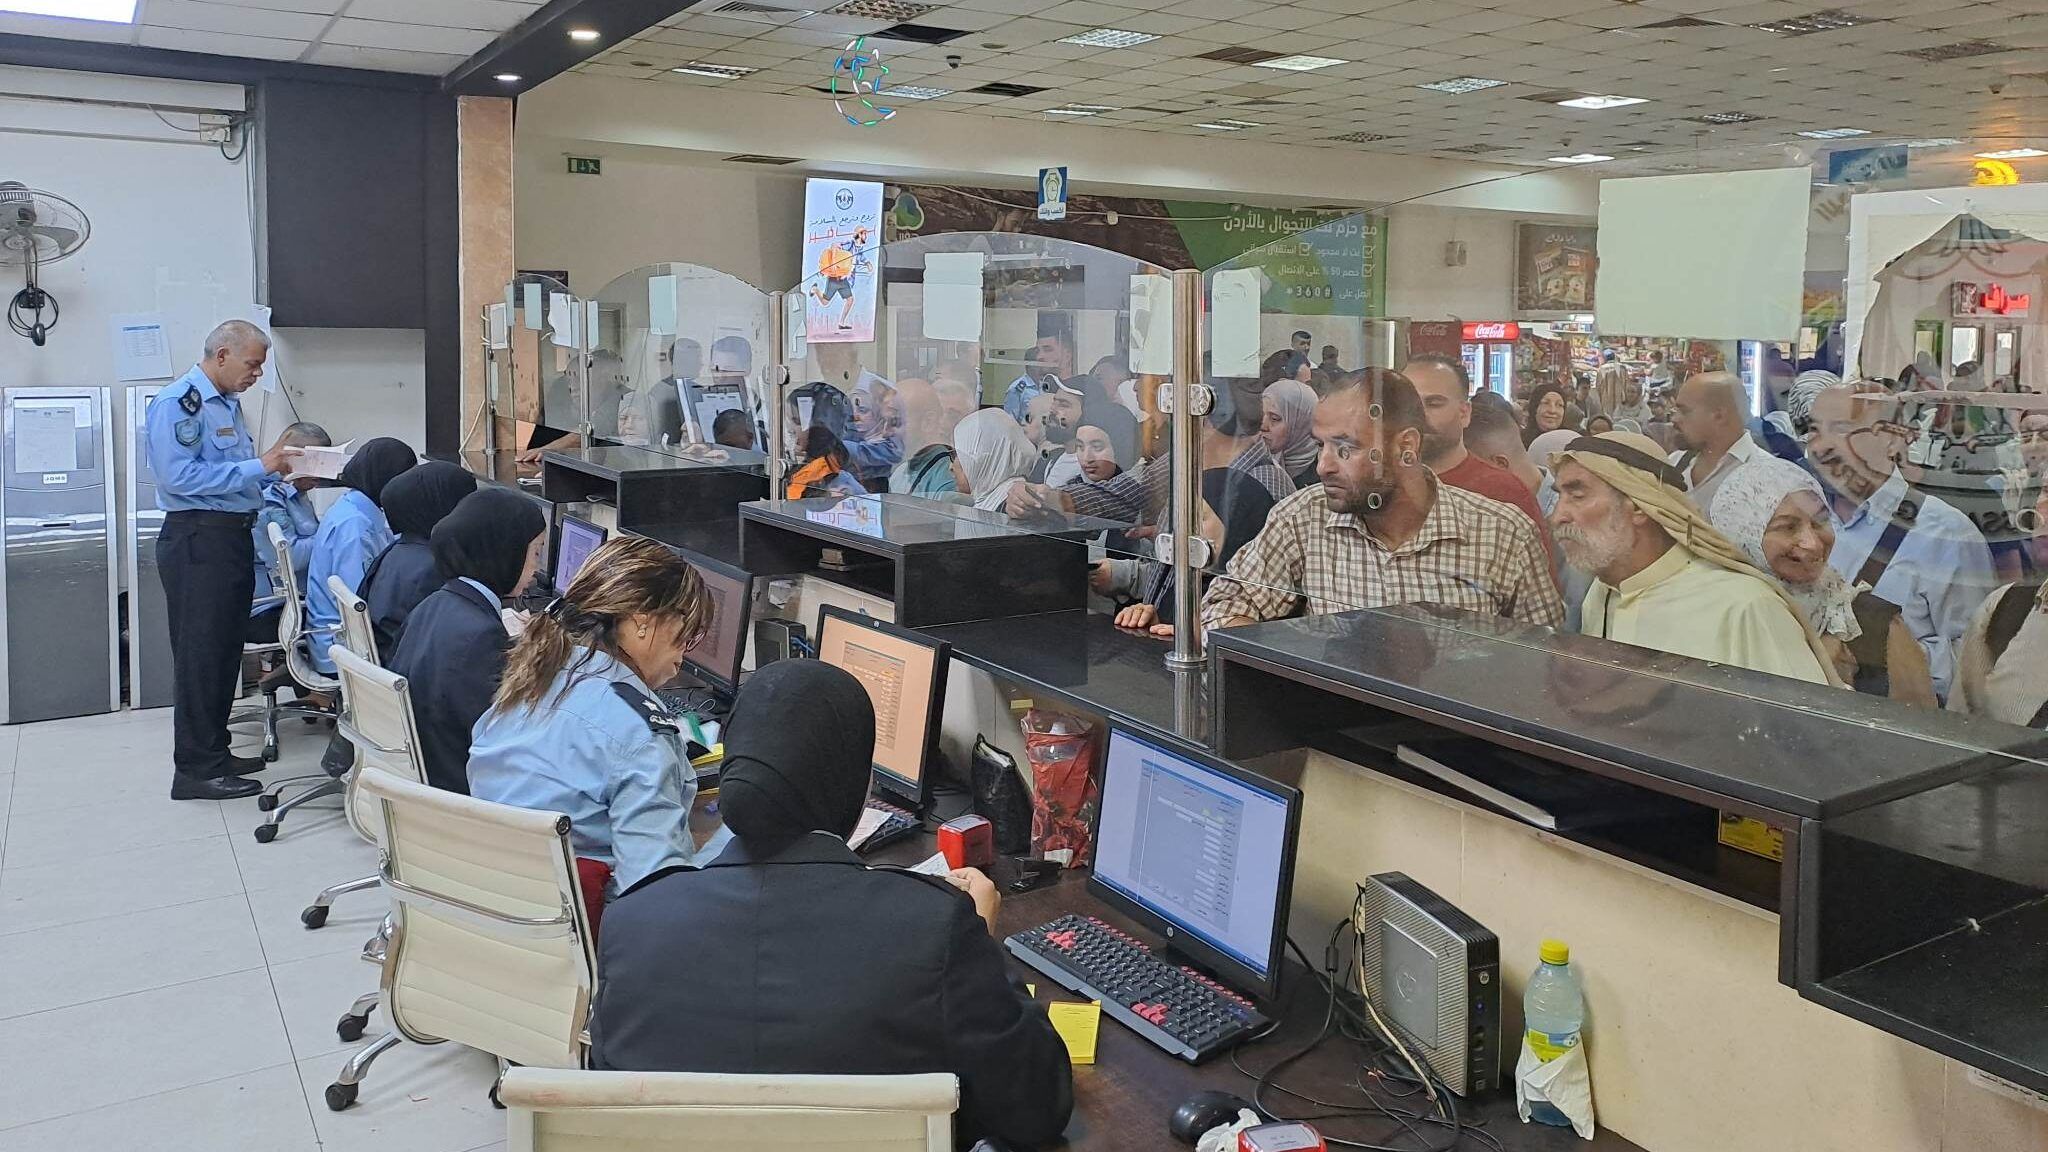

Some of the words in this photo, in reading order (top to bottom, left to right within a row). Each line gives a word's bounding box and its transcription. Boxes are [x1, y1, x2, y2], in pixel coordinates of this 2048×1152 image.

[1223, 211, 1265, 232] بالأردن
[1269, 214, 1313, 235] التجوال
[1361, 226, 1377, 238] مع
